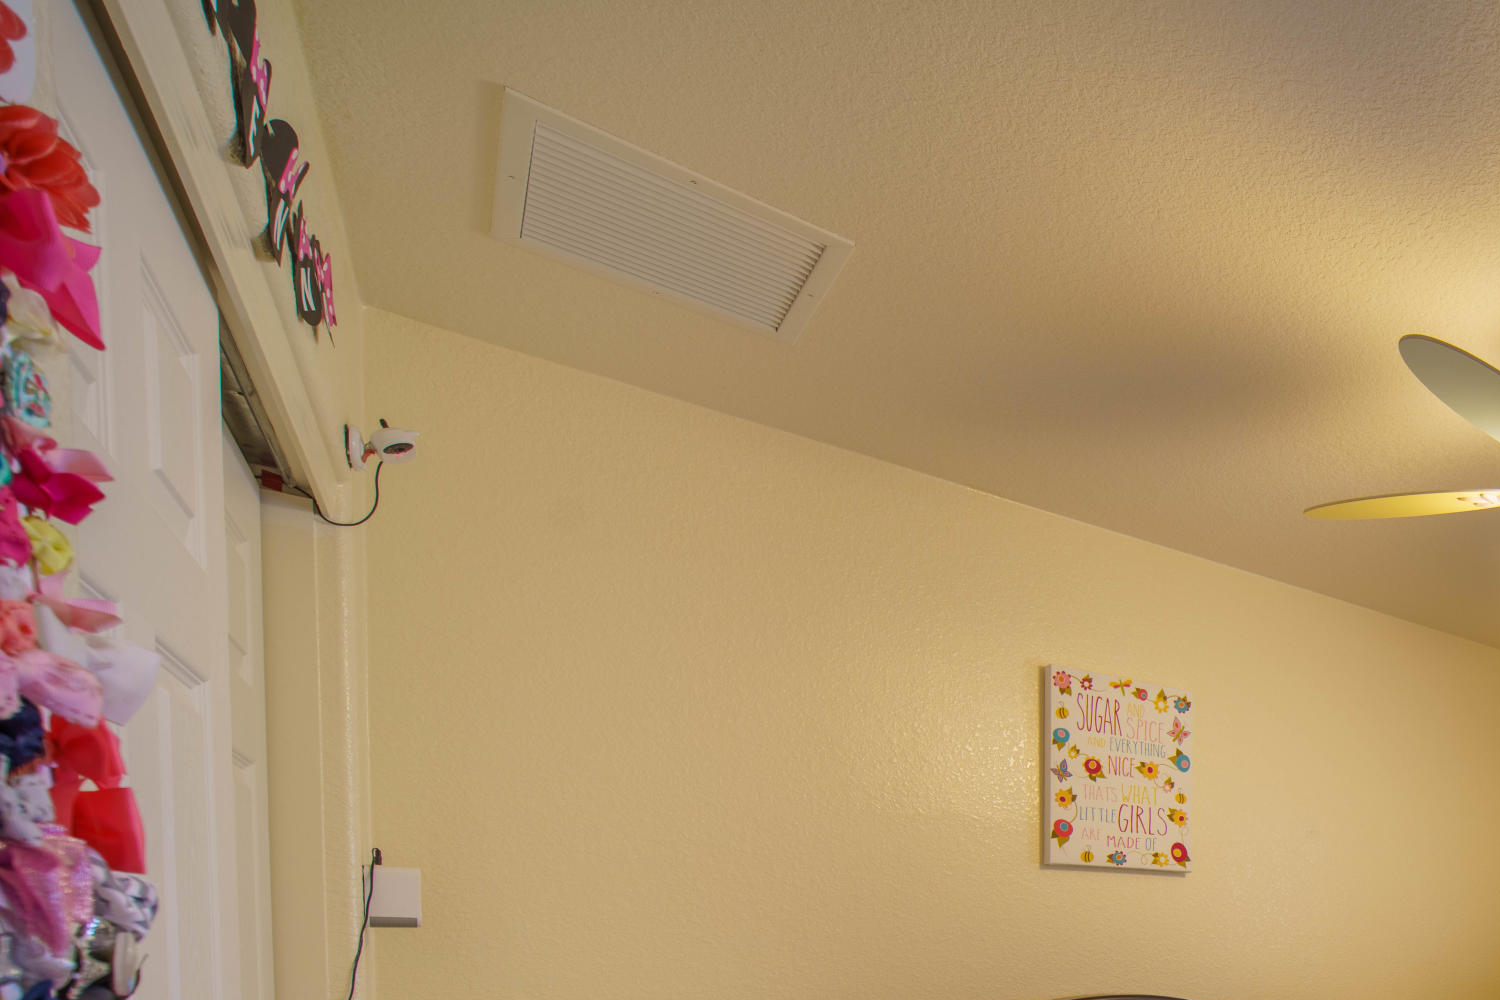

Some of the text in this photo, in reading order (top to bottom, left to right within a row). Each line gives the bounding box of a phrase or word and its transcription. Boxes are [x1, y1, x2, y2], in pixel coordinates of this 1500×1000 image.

[1076, 692, 1122, 737] SUGAR
[1126, 716, 1164, 744] SPICE
[1109, 736, 1166, 758] EVERYTHING
[1108, 755, 1136, 778] NICE
[1121, 783, 1158, 807] WHAT
[1079, 803, 1168, 837] LITTLE GIRLS
[1106, 835, 1158, 852] MADE OF
